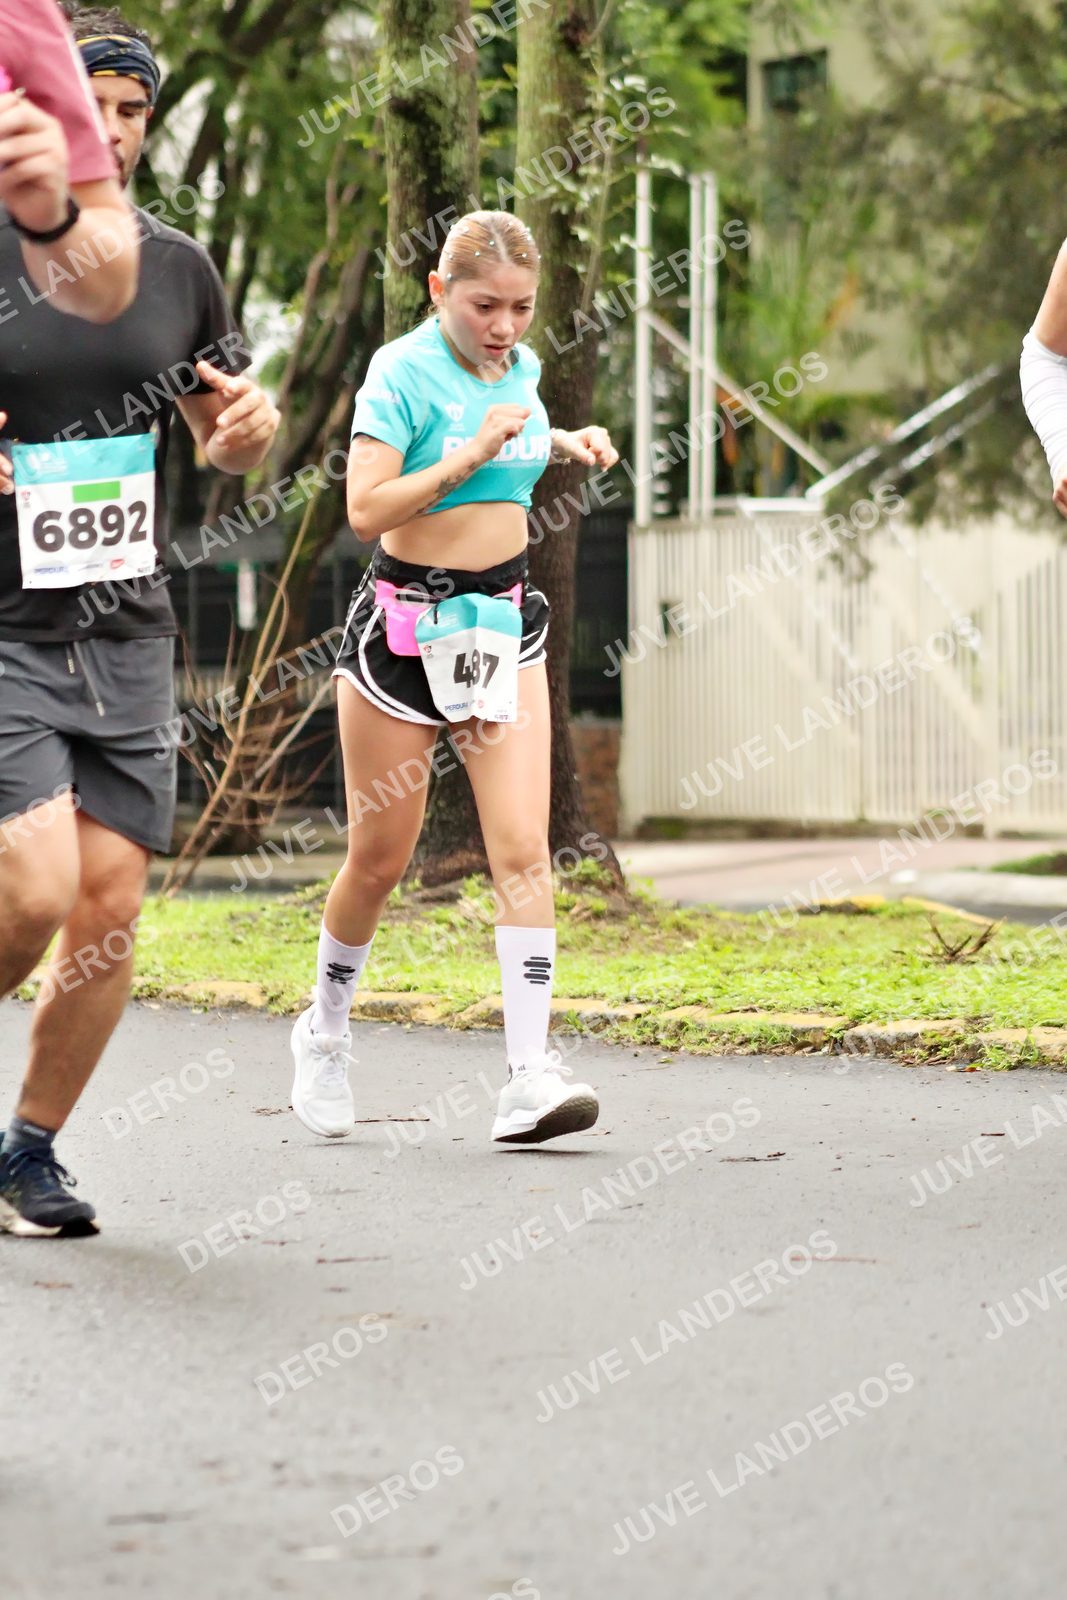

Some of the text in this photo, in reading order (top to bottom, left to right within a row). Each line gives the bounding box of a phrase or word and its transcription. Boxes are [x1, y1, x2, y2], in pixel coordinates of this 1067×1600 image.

[442, 436, 551, 462] PDUR
[33, 500, 148, 553] 6892
[453, 649, 500, 689] 487
